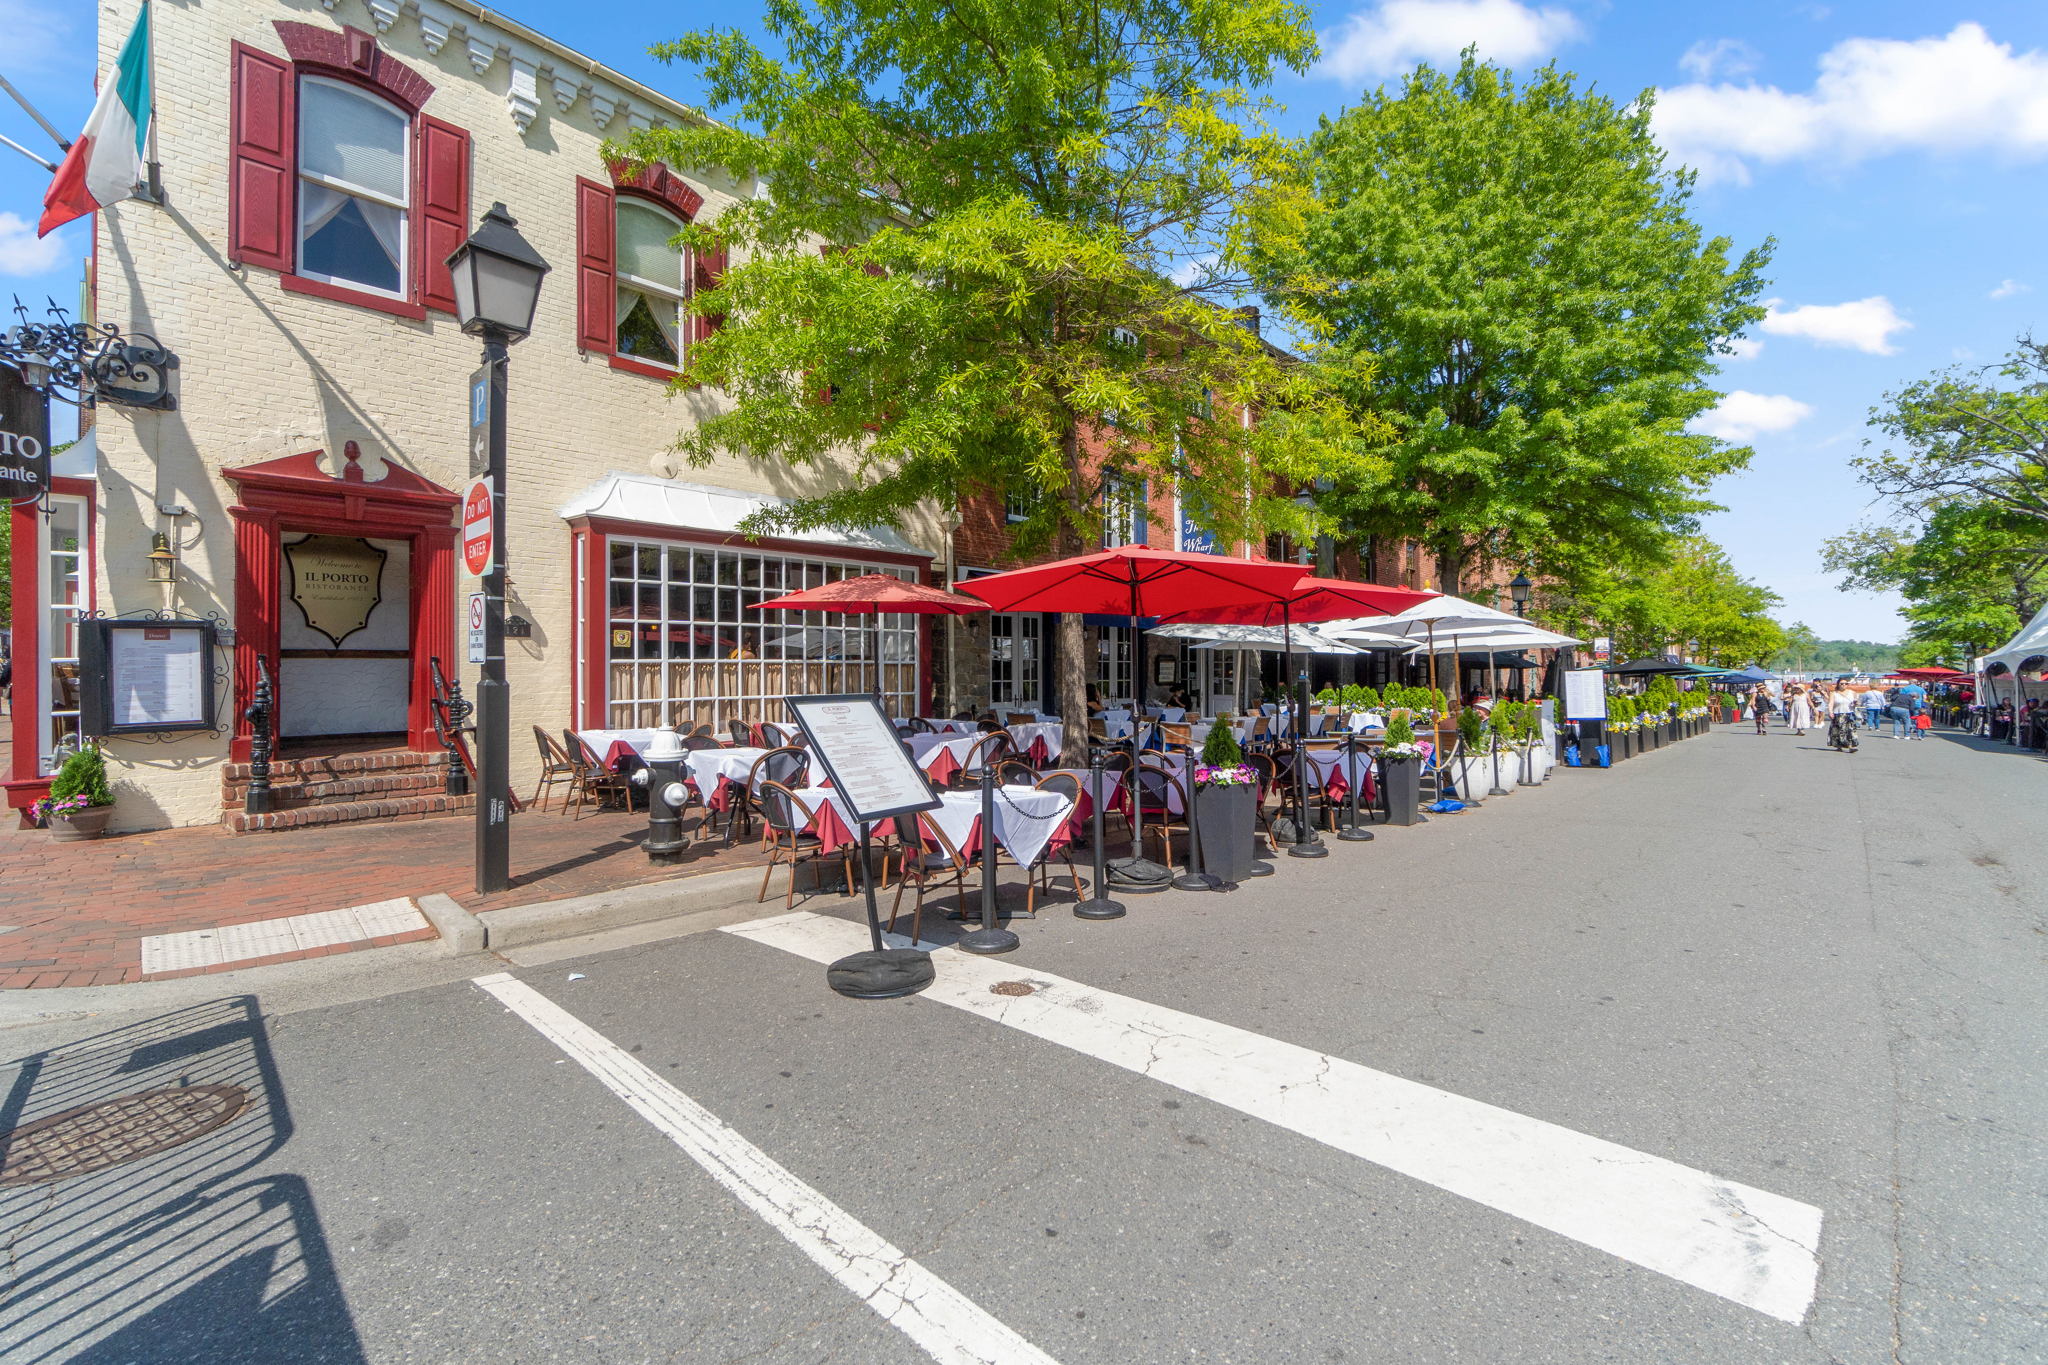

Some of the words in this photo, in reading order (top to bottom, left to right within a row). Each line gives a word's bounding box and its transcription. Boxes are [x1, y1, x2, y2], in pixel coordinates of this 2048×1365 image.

[475, 385, 484, 423] P
[0, 430, 42, 459] TO
[0, 465, 38, 483] ante
[467, 503, 475, 520] DO
[477, 496, 489, 516] NOT
[468, 540, 487, 559] ENTER
[1183, 537, 1216, 555] Wharf
[305, 572, 319, 582] IL
[321, 573, 369, 584] PORTO
[305, 583, 368, 592] RISTORANTE
